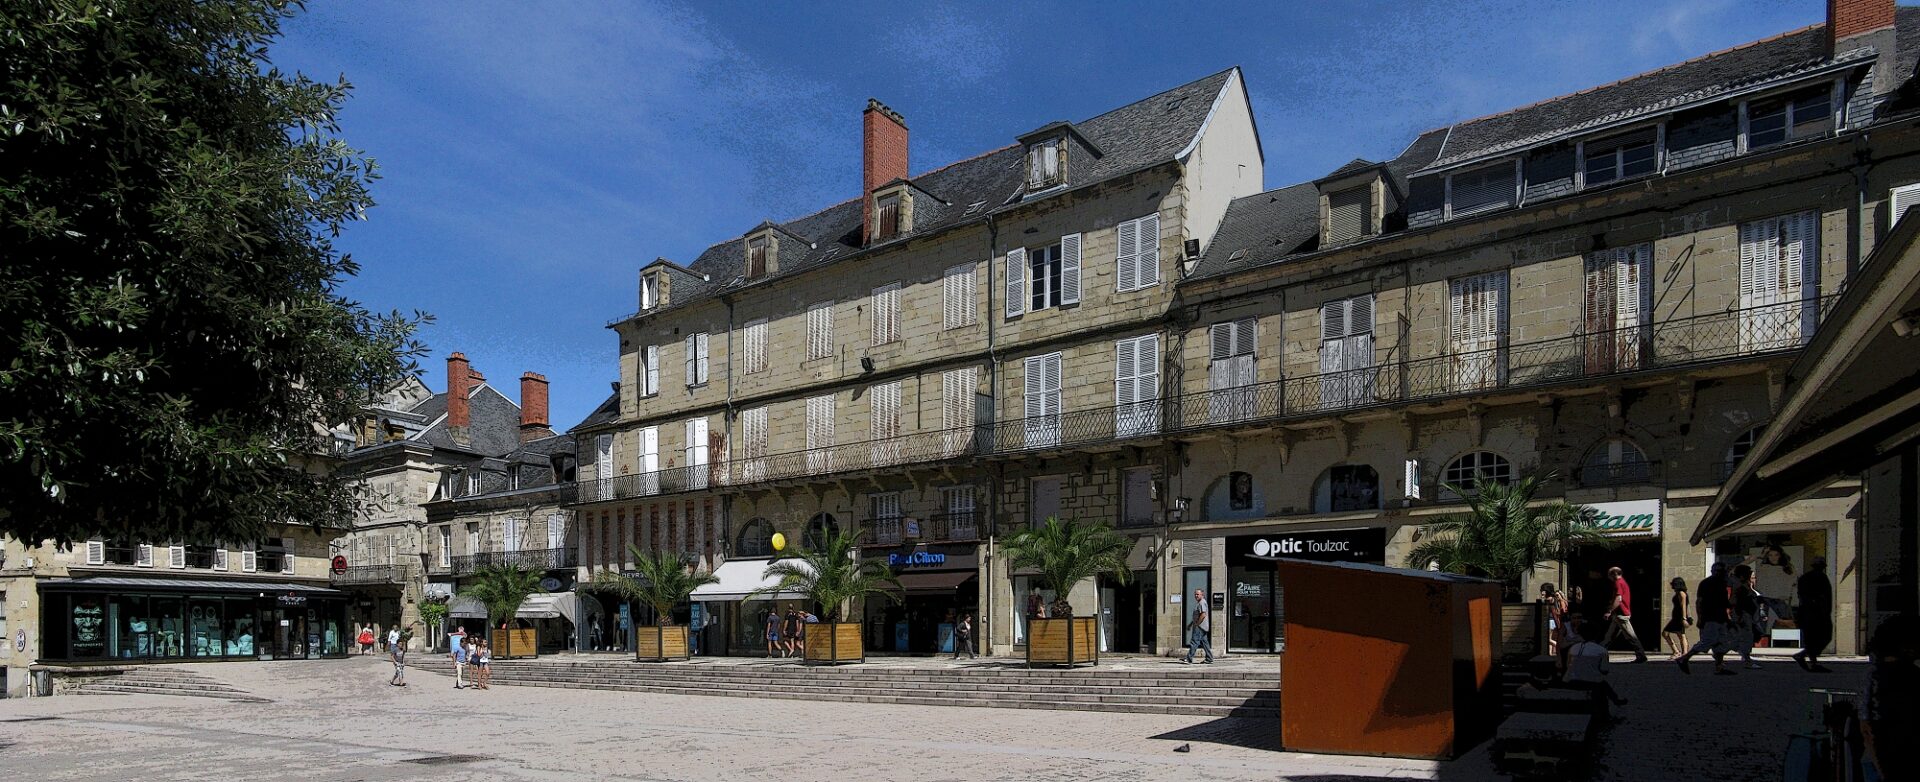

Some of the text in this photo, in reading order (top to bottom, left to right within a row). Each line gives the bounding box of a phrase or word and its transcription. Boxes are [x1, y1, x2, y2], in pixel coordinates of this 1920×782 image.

[1253, 538, 1350, 557] Optic Toulzac
[914, 551, 945, 564] Citron
